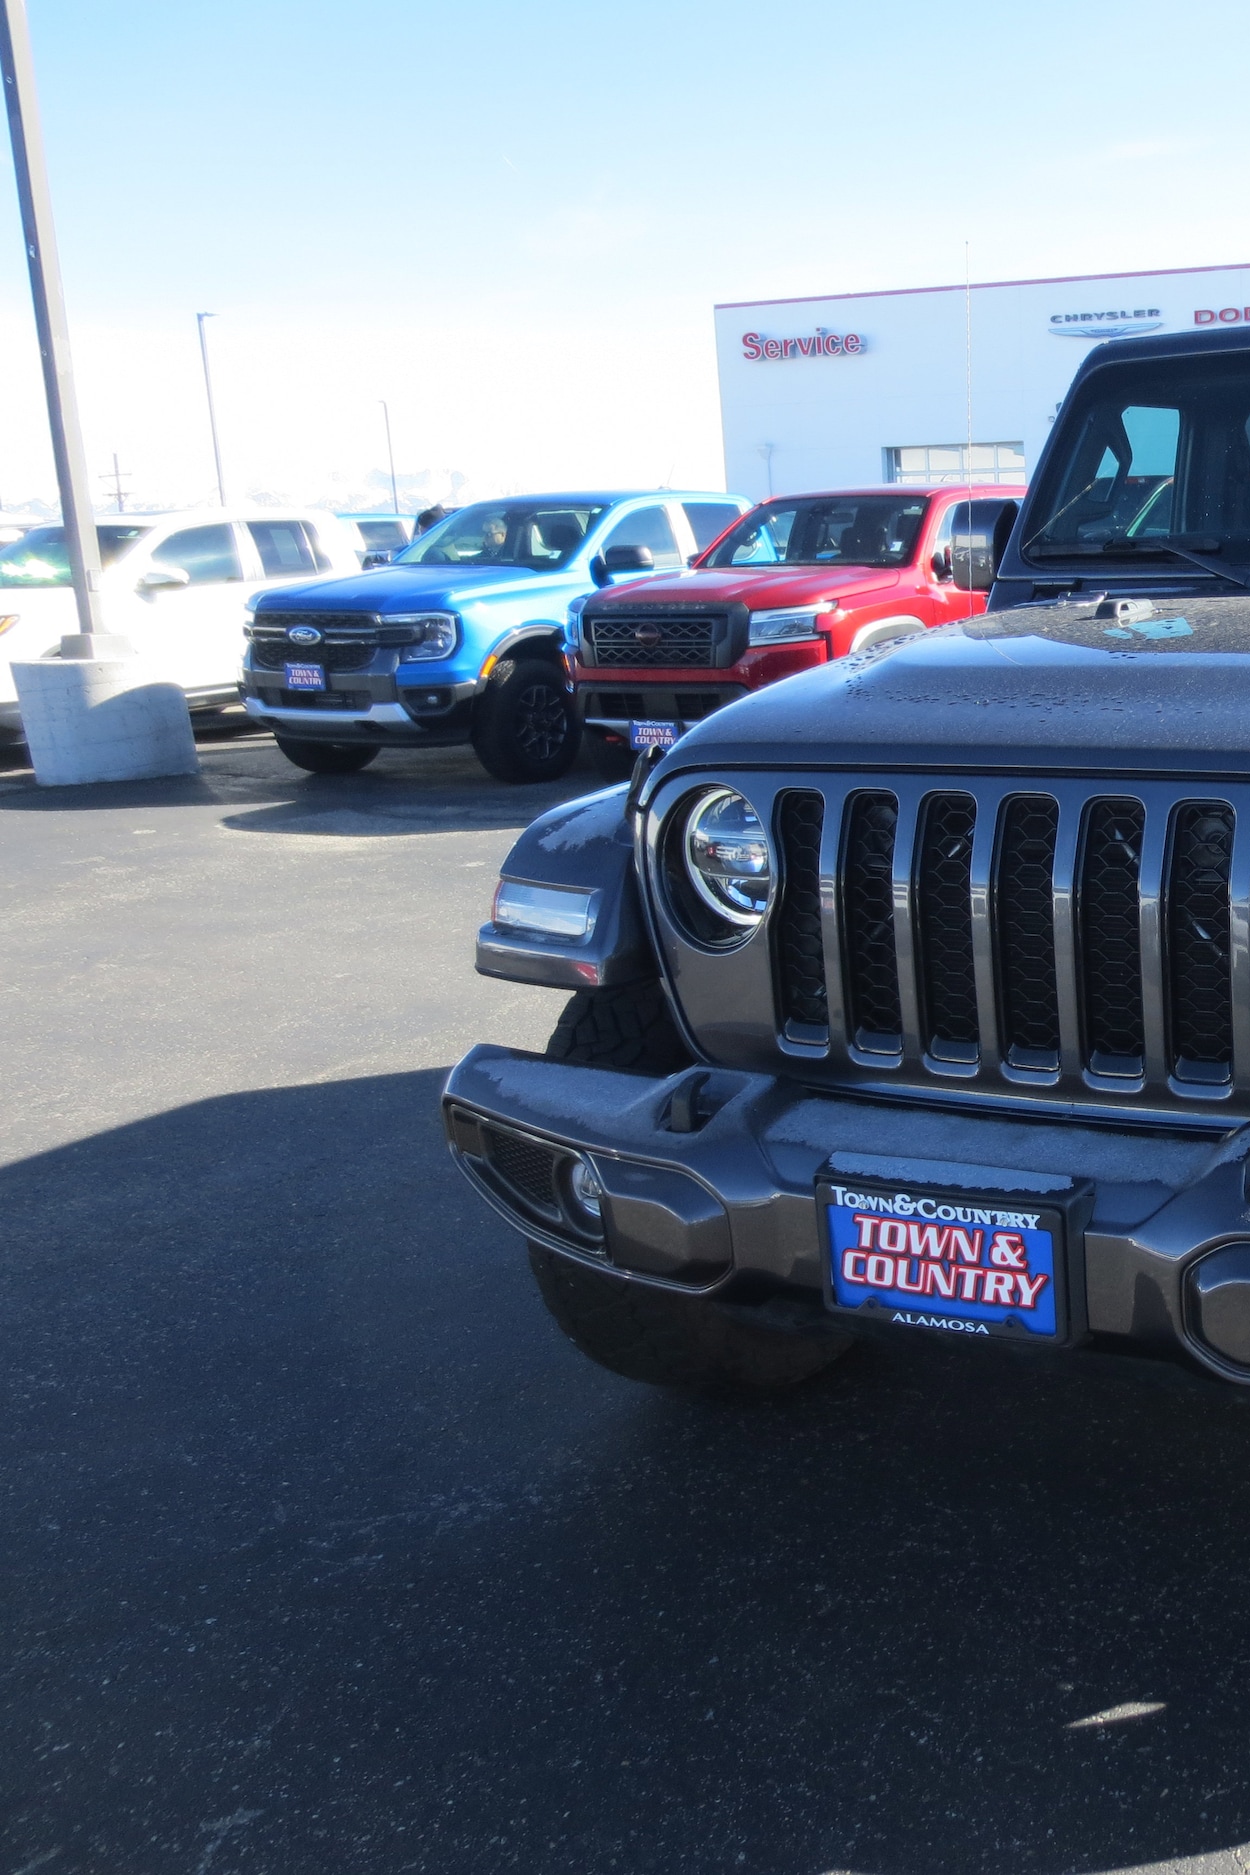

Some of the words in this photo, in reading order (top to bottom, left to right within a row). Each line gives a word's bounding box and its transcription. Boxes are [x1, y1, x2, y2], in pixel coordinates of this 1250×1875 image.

[1049, 308, 1161, 324] CHRYSLER
[741, 326, 863, 362] Service
[289, 676, 322, 686] COUNTRY
[291, 669, 313, 678] TOWN
[638, 727, 664, 736] TOWN
[634, 735, 676, 745] COUNTRY
[853, 1213, 984, 1265] TOWN
[990, 1231, 1028, 1270] &
[841, 1248, 1049, 1309] COUNTRY
[892, 1311, 990, 1336] ALAMOSA
